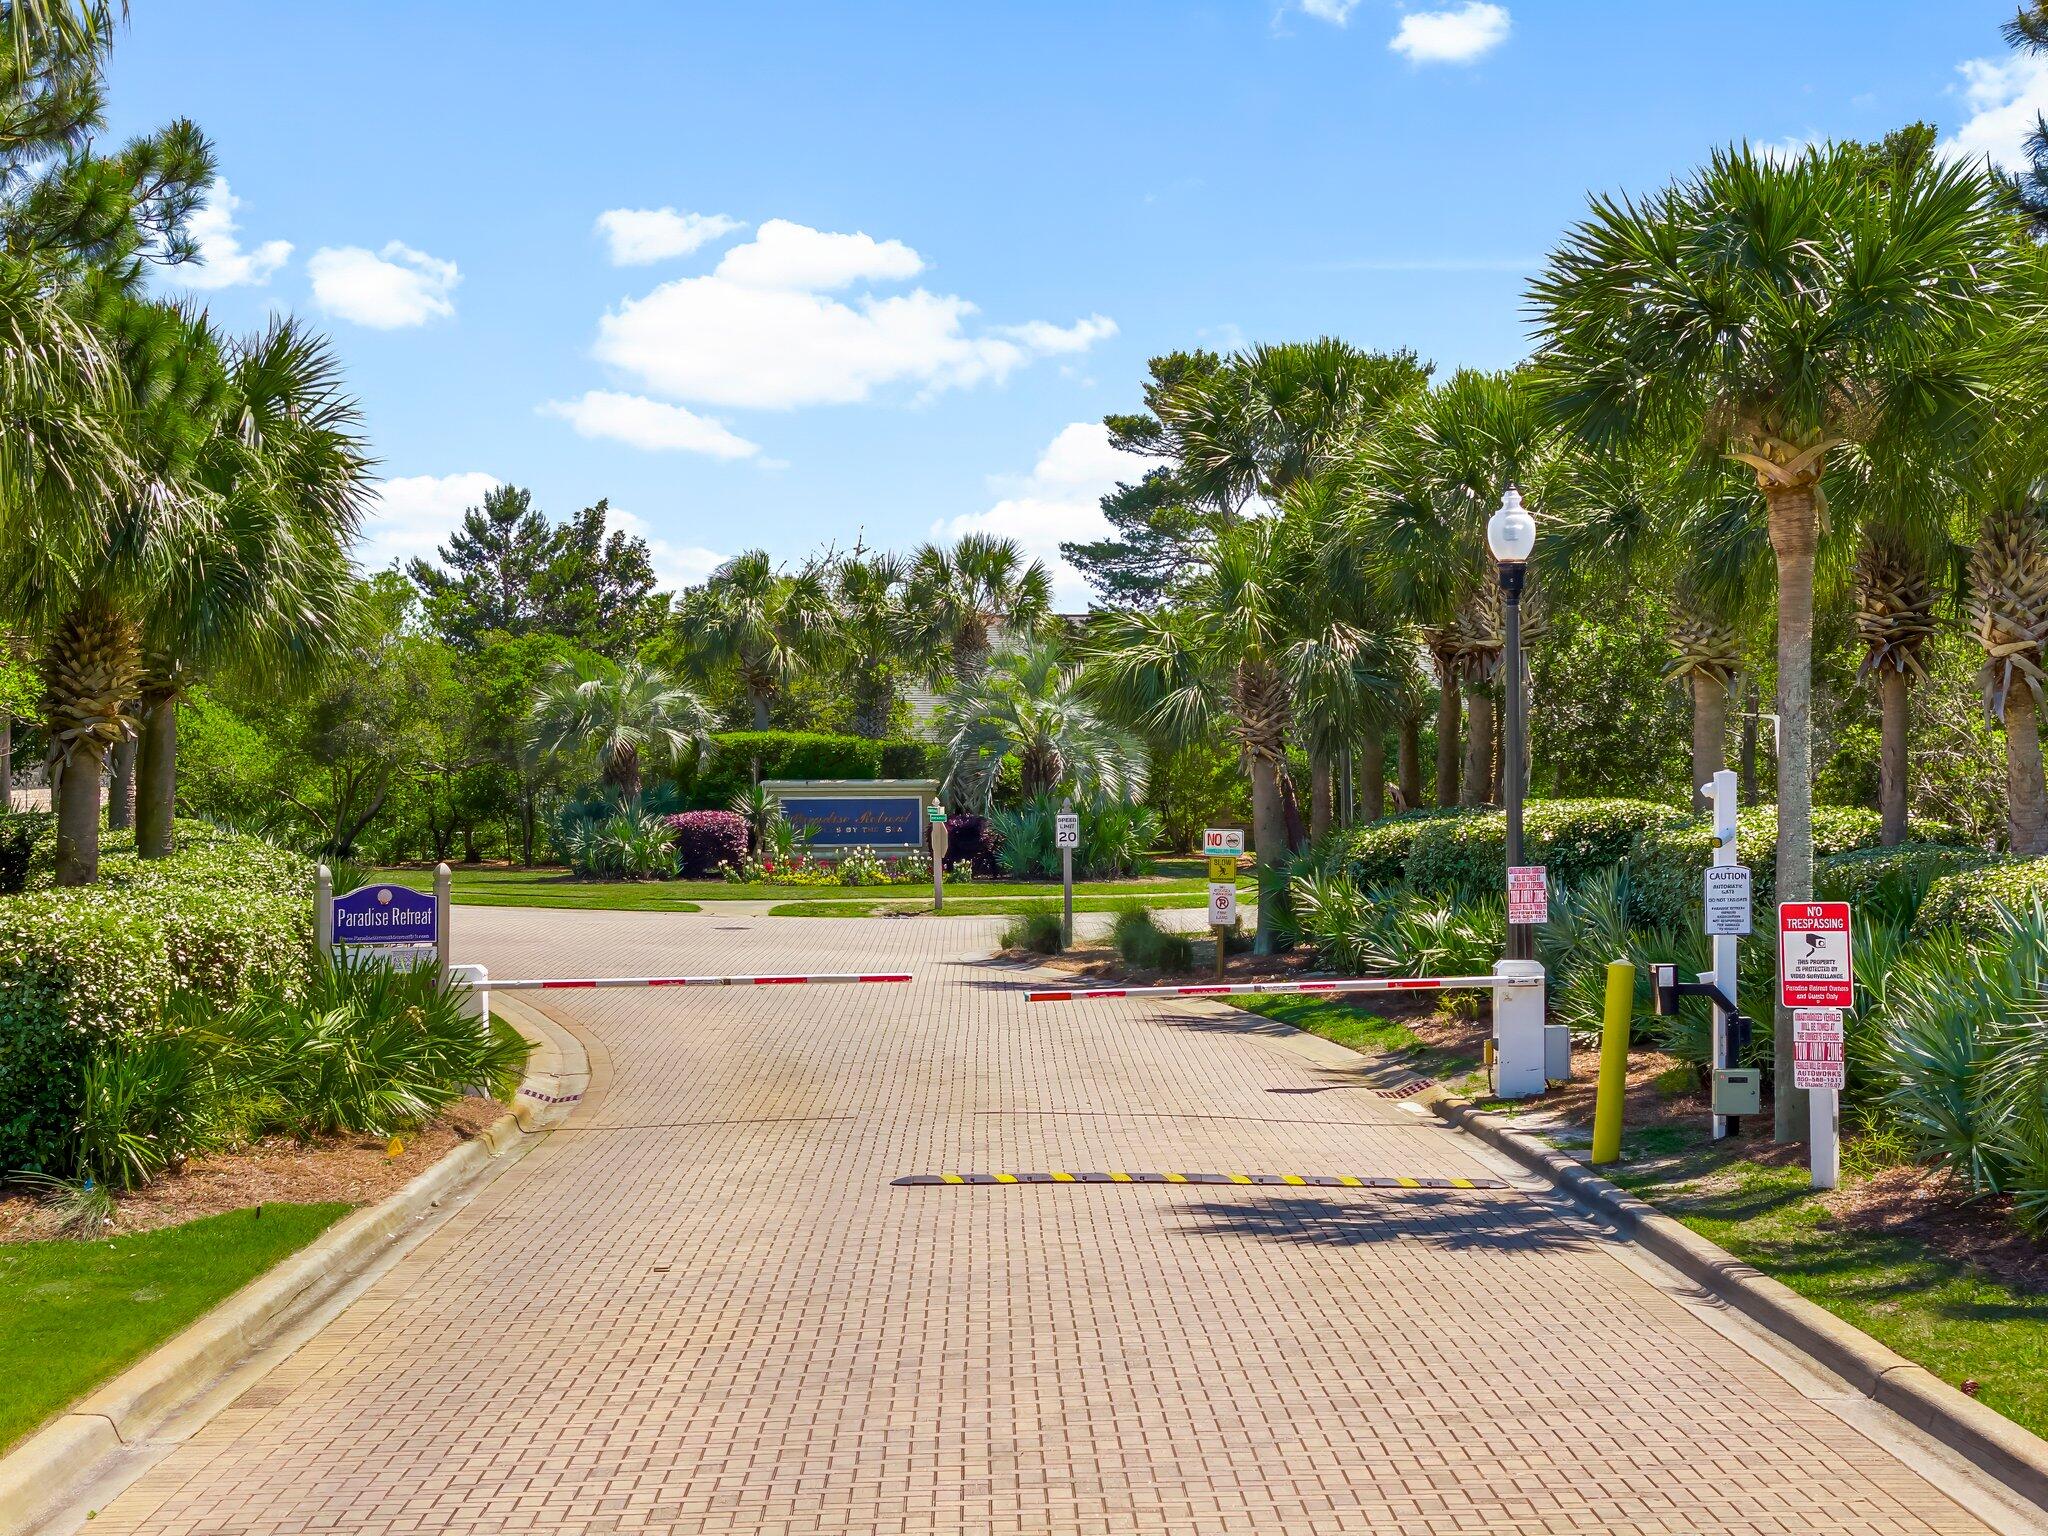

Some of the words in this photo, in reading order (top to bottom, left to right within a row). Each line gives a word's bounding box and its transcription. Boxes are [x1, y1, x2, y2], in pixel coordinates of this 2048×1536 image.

[1058, 831, 1077, 842] 20
[1207, 833, 1222, 846] NO
[1213, 858, 1232, 866] SLOW
[1710, 872, 1747, 880] CAUTION
[338, 907, 389, 927] Paradise
[392, 907, 433, 925] Retreat
[1807, 906, 1823, 917] NO
[1787, 918, 1844, 929] TRESPASSING
[1825, 993, 1839, 1001] Only
[1795, 1042, 1808, 1060] TOW
[1809, 1042, 1825, 1060] AWAY
[1827, 1042, 1843, 1061] ZONE
